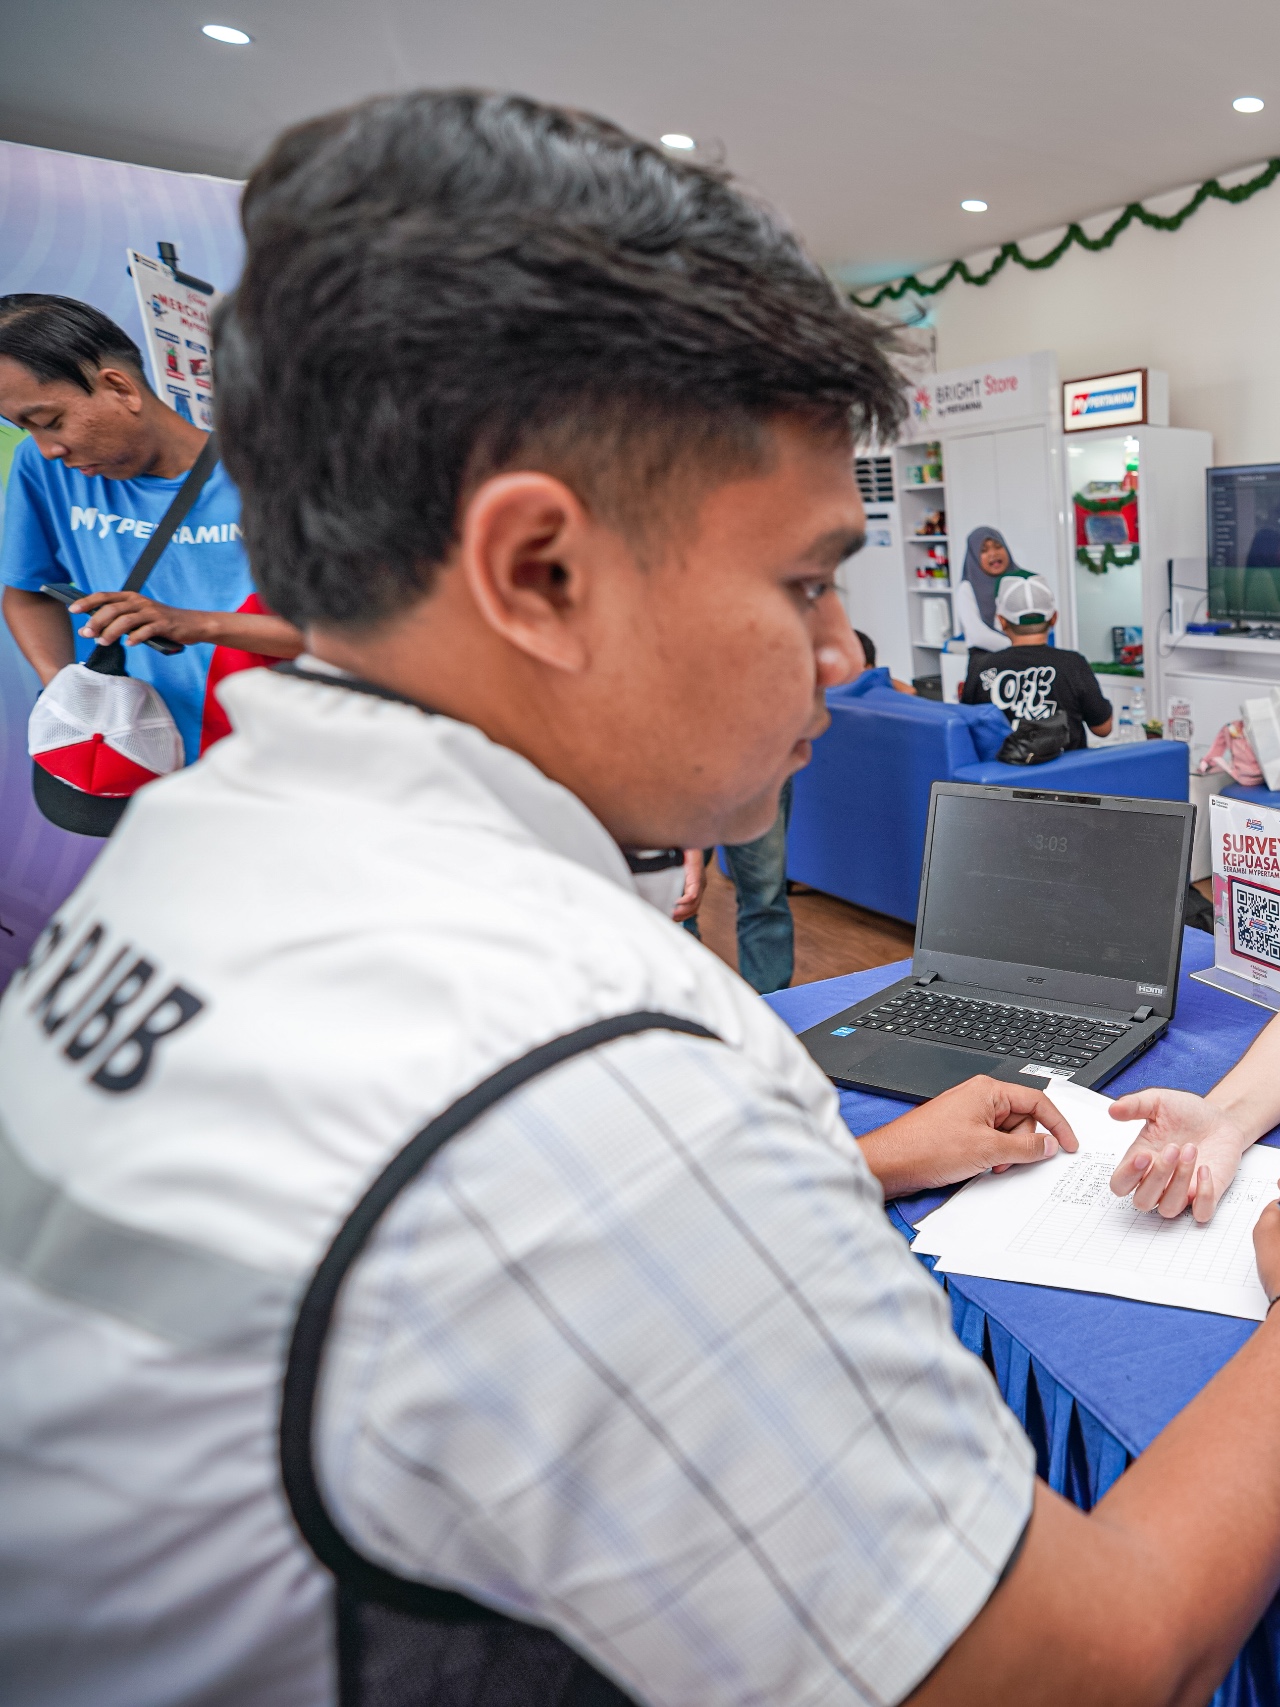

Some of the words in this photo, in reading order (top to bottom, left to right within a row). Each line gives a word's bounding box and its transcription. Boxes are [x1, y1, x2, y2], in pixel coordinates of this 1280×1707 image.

[935, 379, 982, 404] BRIGHT
[984, 373, 1019, 396] Store
[1034, 834, 1068, 853] 3:03
[1223, 866, 1247, 875] SERAMBI
[1027, 976, 1047, 985] acer
[1139, 985, 1164, 995] HDMI
